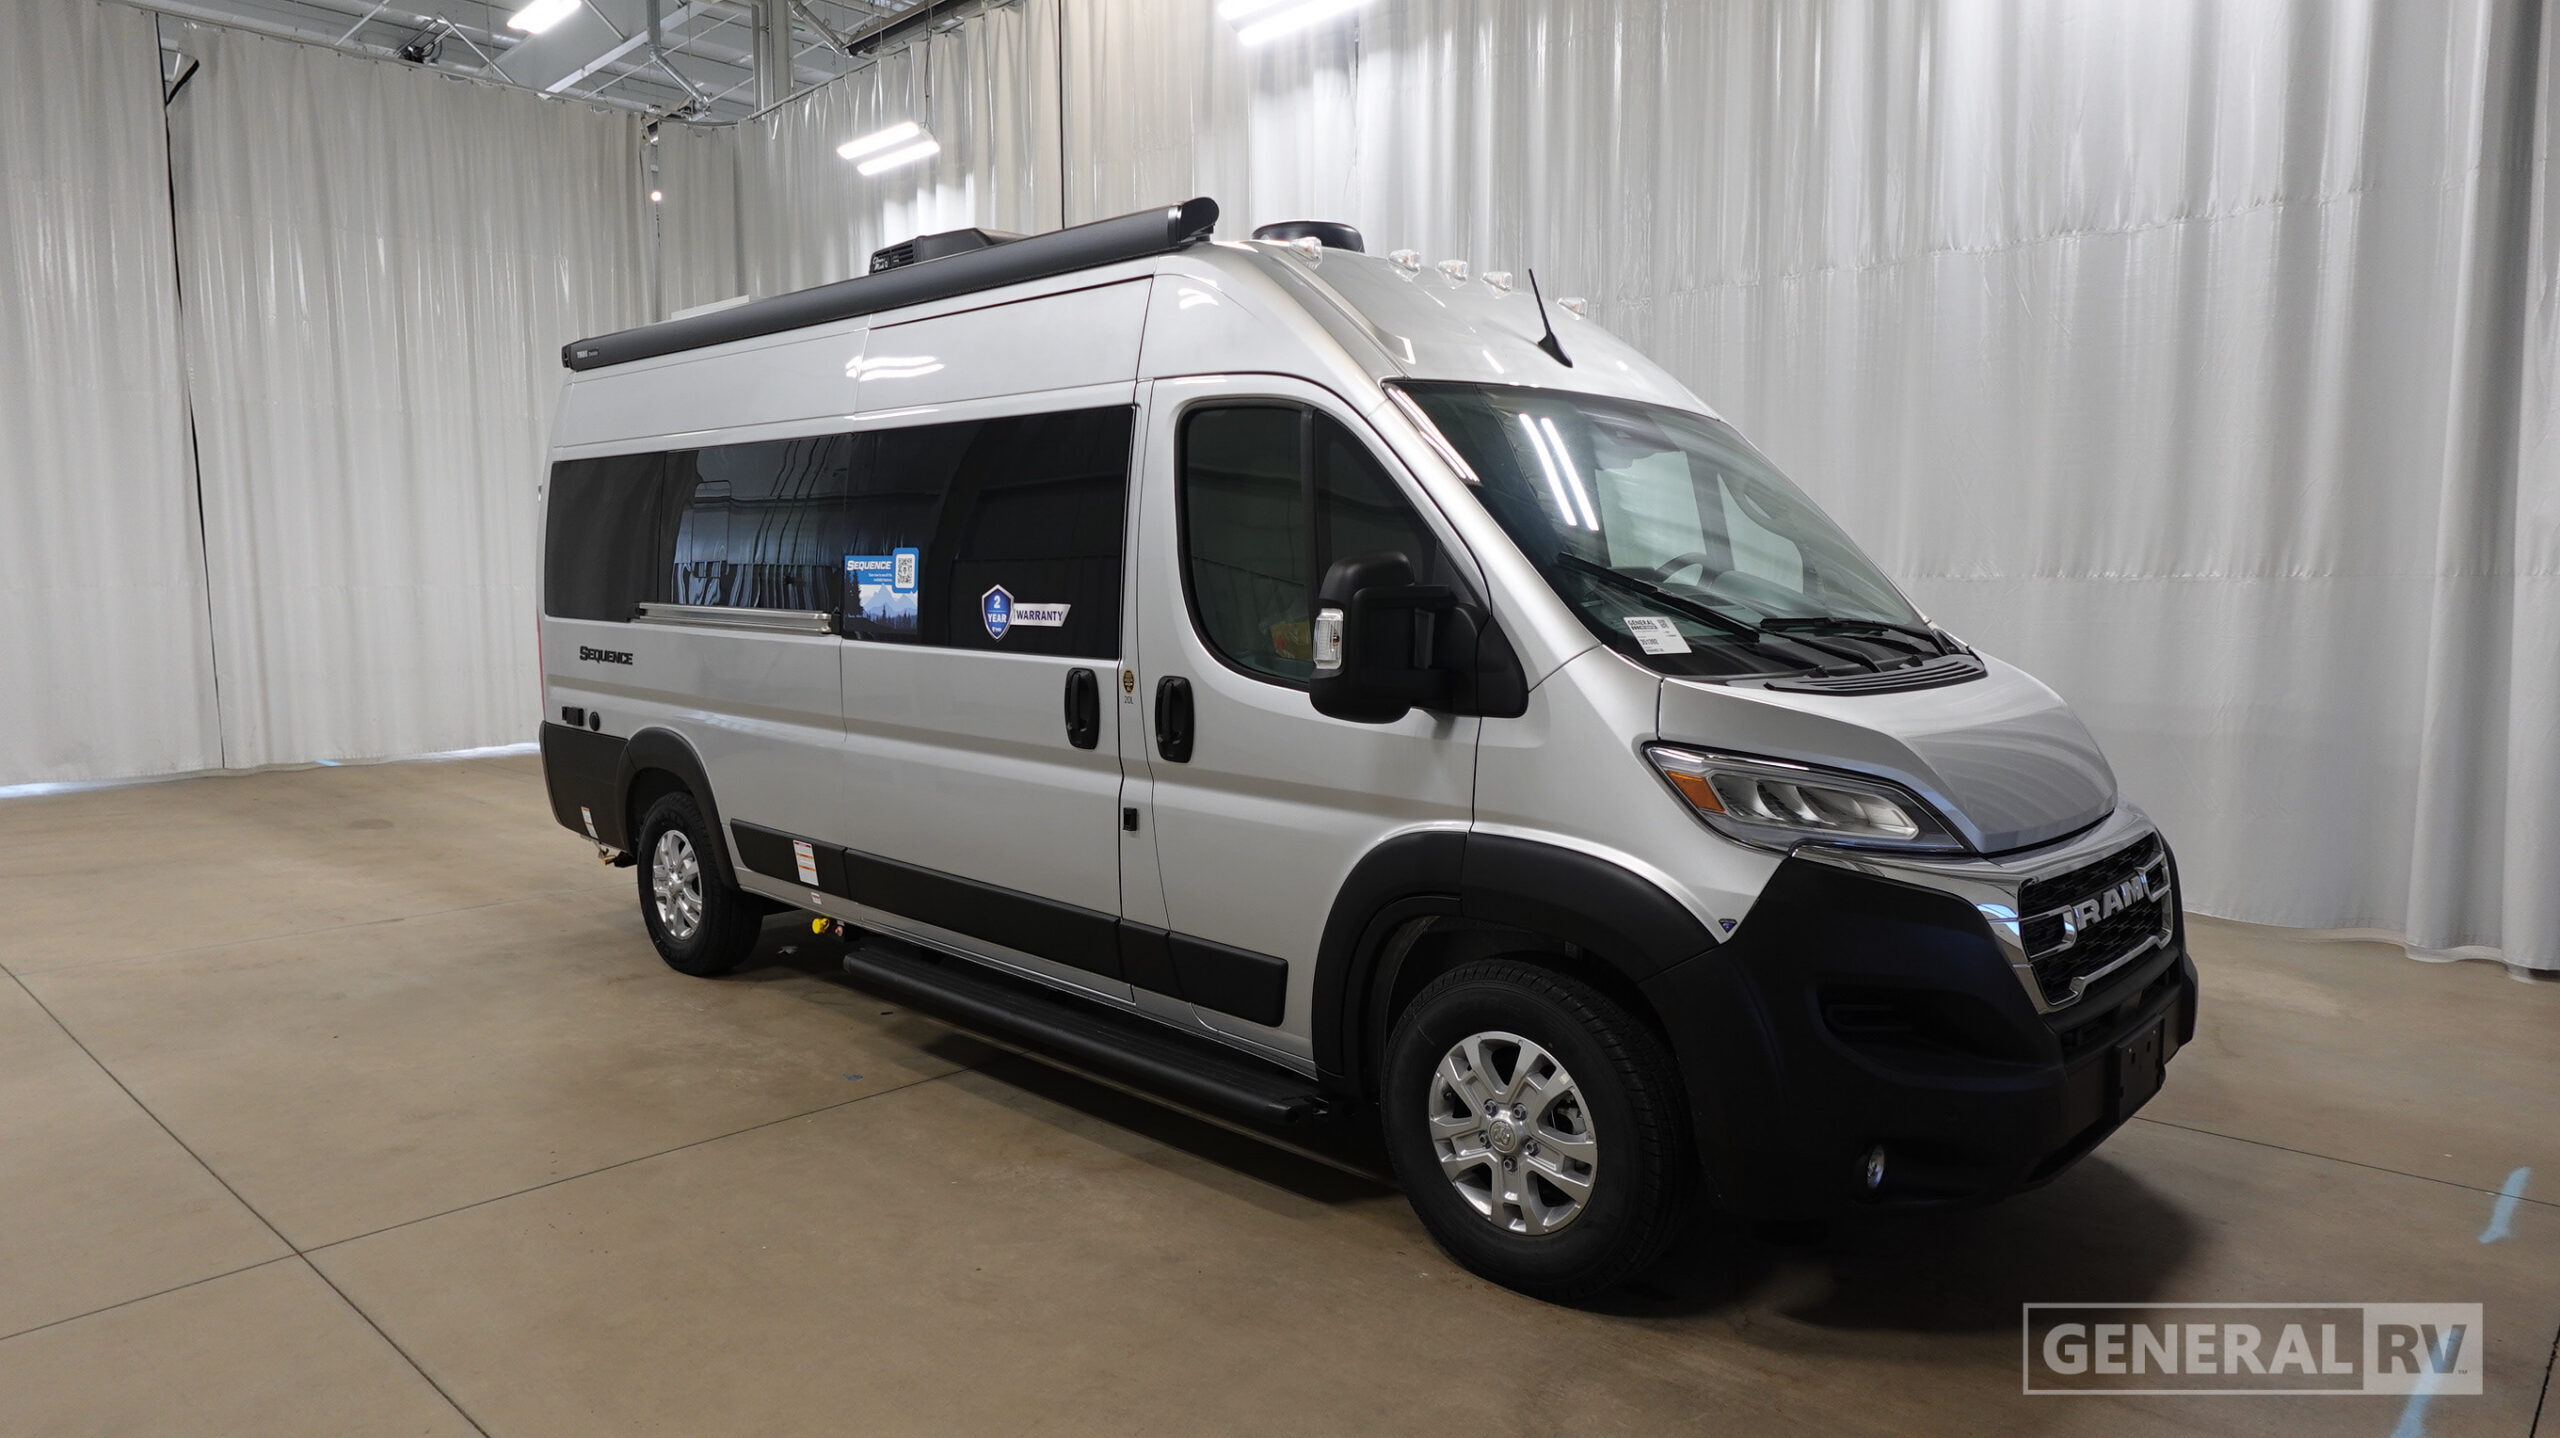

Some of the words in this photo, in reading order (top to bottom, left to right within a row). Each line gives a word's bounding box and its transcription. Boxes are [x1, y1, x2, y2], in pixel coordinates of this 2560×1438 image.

[847, 560, 893, 571] SEQUENCE
[993, 595, 1001, 609] 2
[987, 613, 1007, 623] YEAR
[1016, 610, 1064, 621] WARRANTY
[579, 645, 633, 665] SEQUENCE
[2072, 875, 2145, 932] RAM
